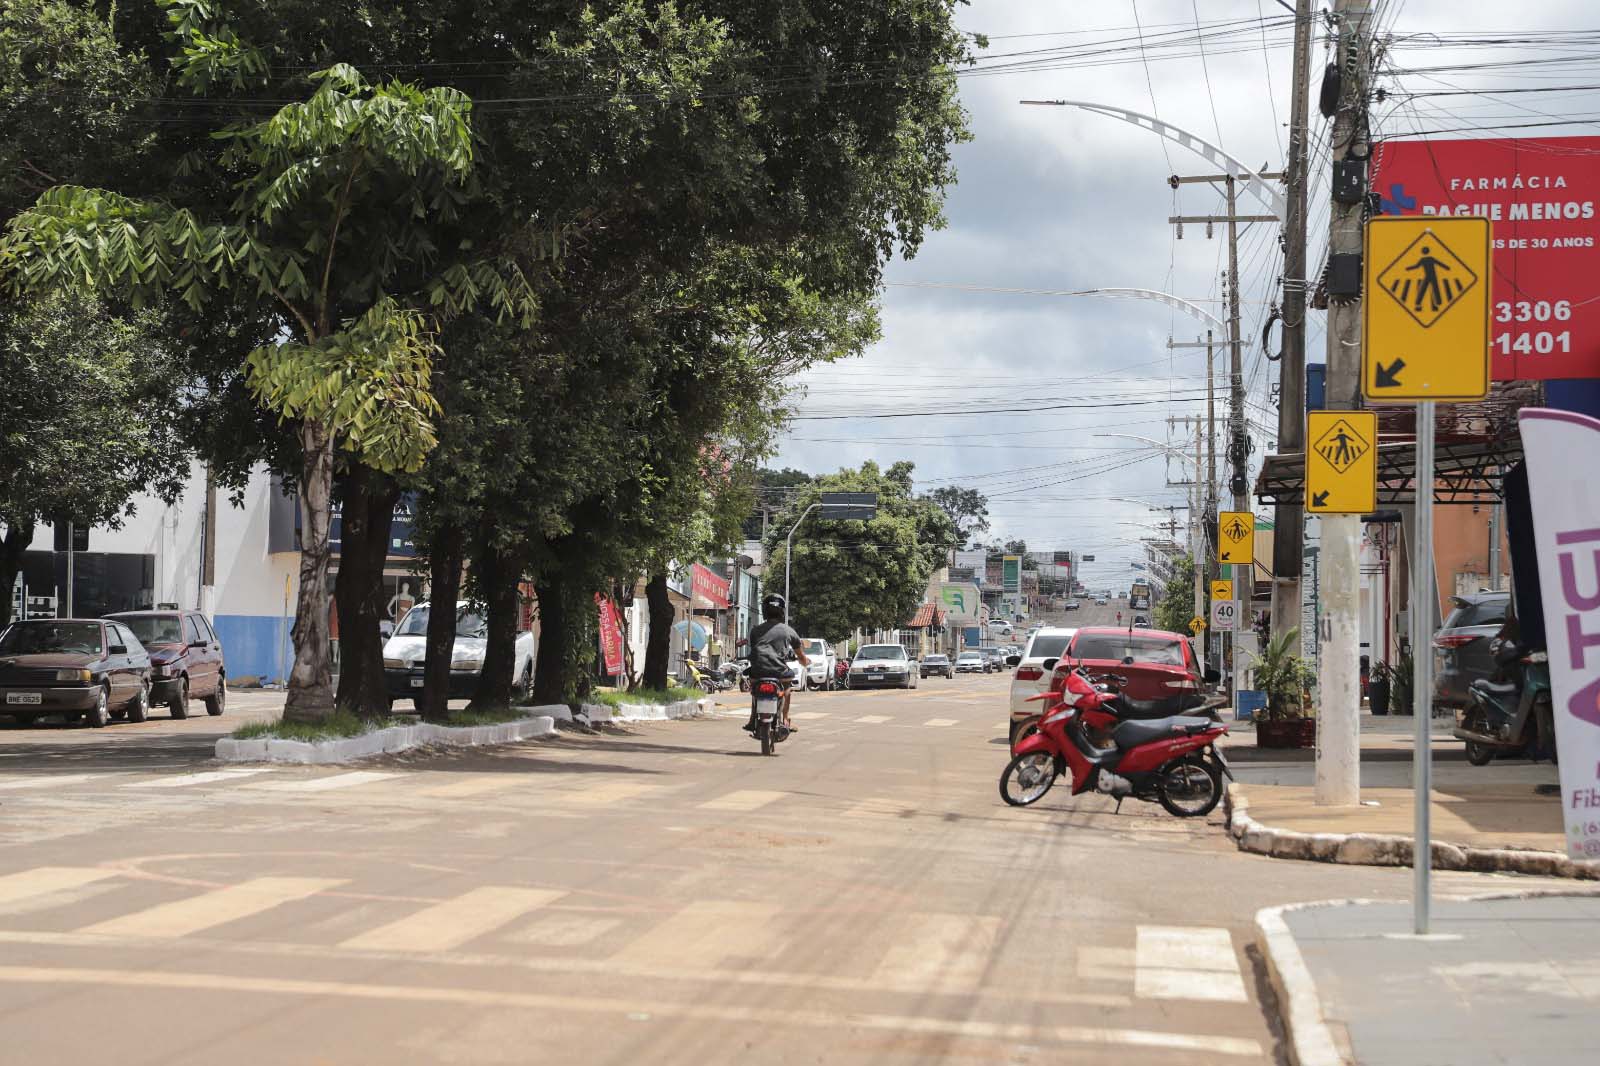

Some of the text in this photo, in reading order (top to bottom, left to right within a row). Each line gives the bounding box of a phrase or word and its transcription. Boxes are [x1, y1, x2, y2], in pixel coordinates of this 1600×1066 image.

[1451, 173, 1568, 190] FARMÁCIA
[1509, 201, 1595, 221] MENOS
[1509, 239, 1528, 249] DE
[1531, 238, 1549, 248] 30
[1552, 237, 1594, 248] ANOS
[1495, 300, 1571, 322] 3306
[1217, 606, 1234, 617] 40
